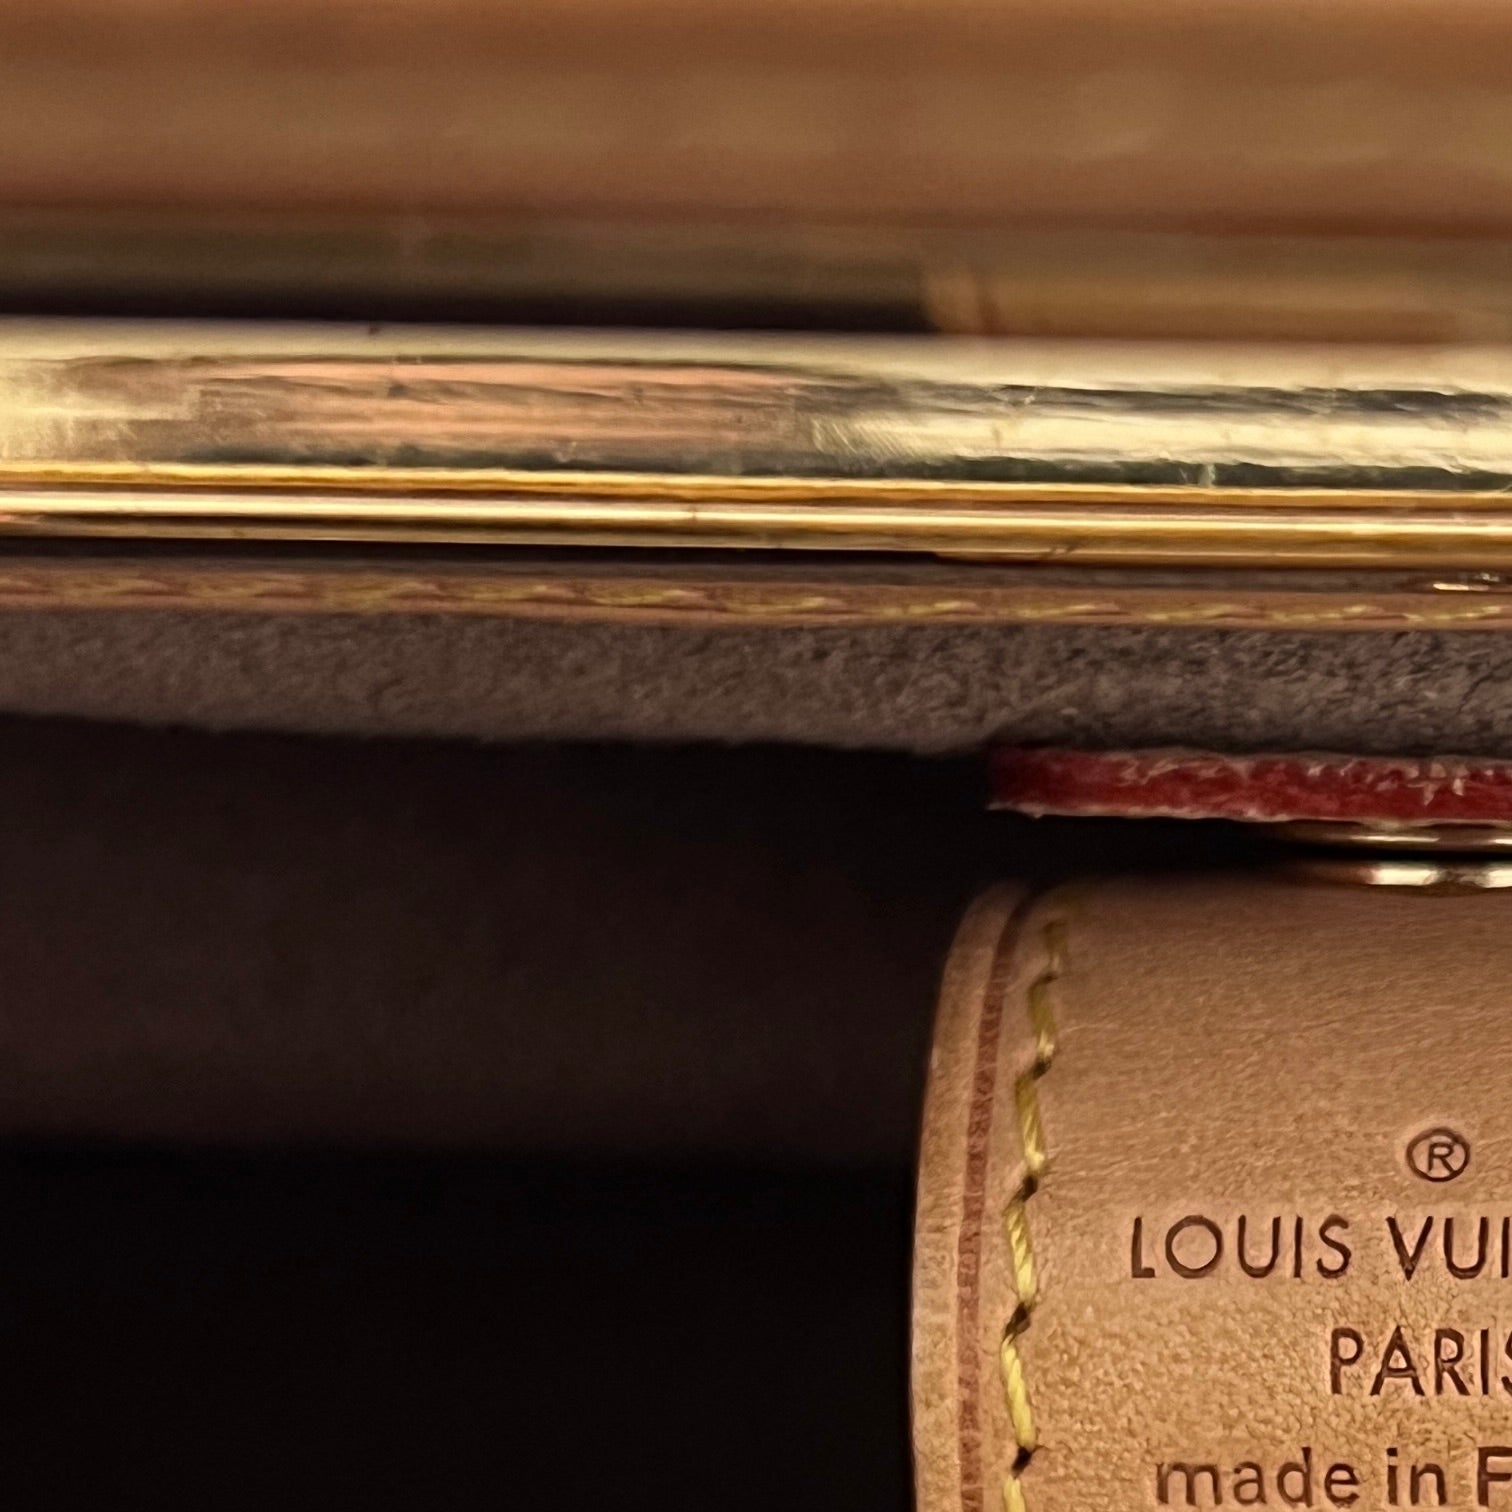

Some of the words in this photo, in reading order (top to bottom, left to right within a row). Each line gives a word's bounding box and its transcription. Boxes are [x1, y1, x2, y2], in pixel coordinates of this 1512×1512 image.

[1130, 1212, 1353, 1281] LOUIS
[1155, 1445, 1361, 1508] made
[1385, 1446, 1449, 1507] in
